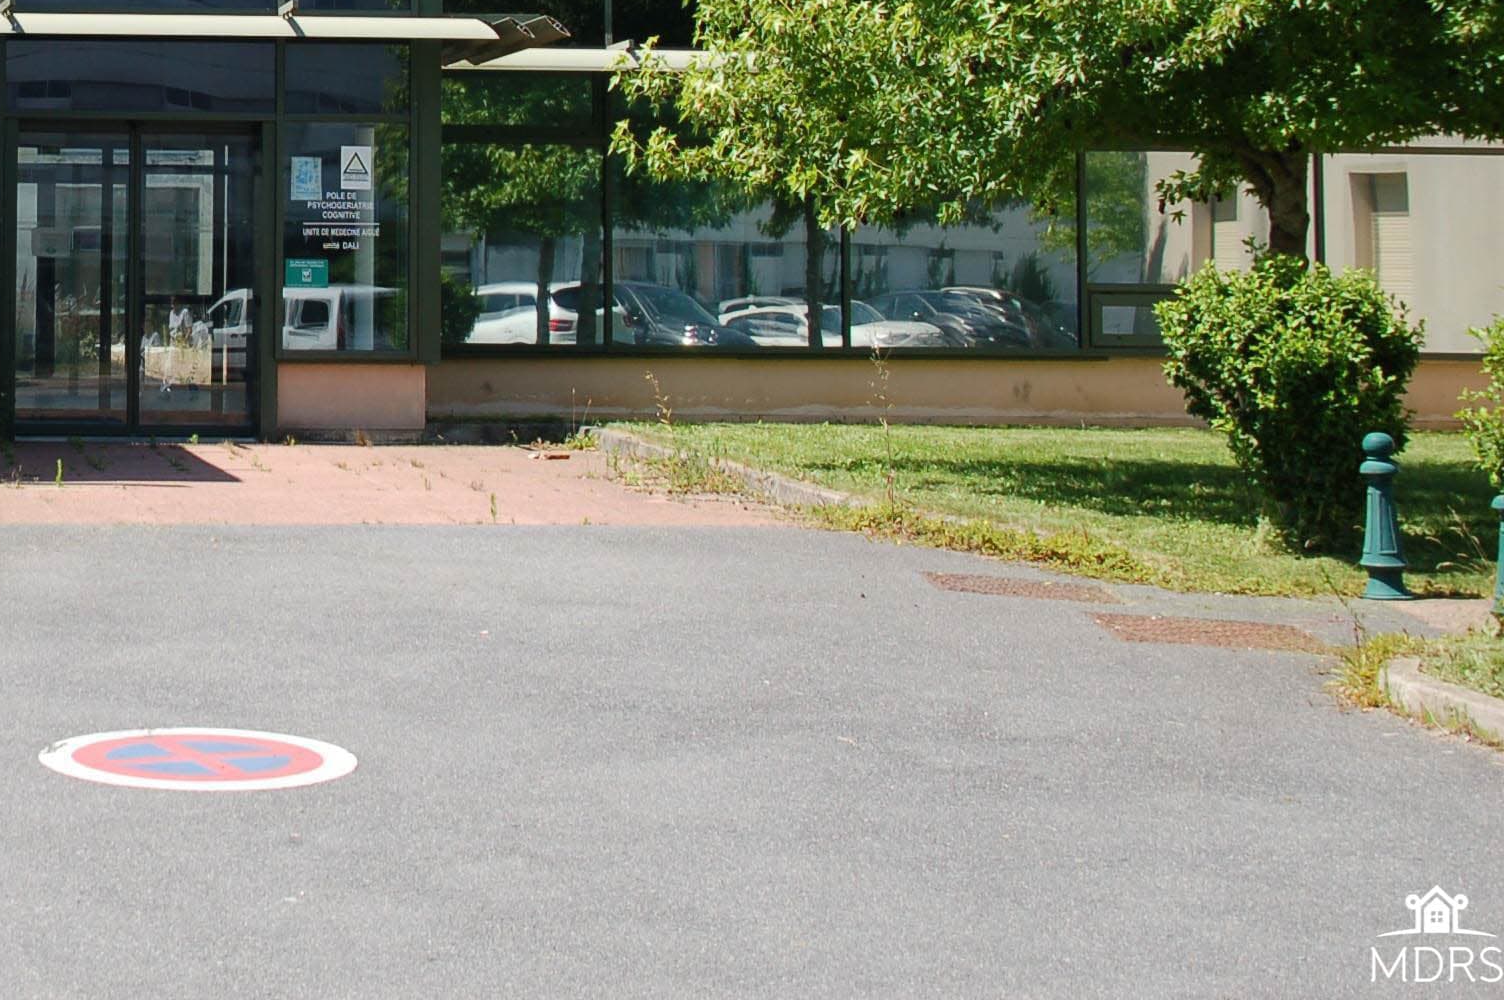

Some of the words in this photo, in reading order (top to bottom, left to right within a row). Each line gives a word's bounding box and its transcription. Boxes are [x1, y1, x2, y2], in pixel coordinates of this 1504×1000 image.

[326, 191, 345, 200] POLE
[346, 191, 357, 200] DE
[322, 211, 361, 219] COGNITIVE
[342, 241, 360, 250] DALI
